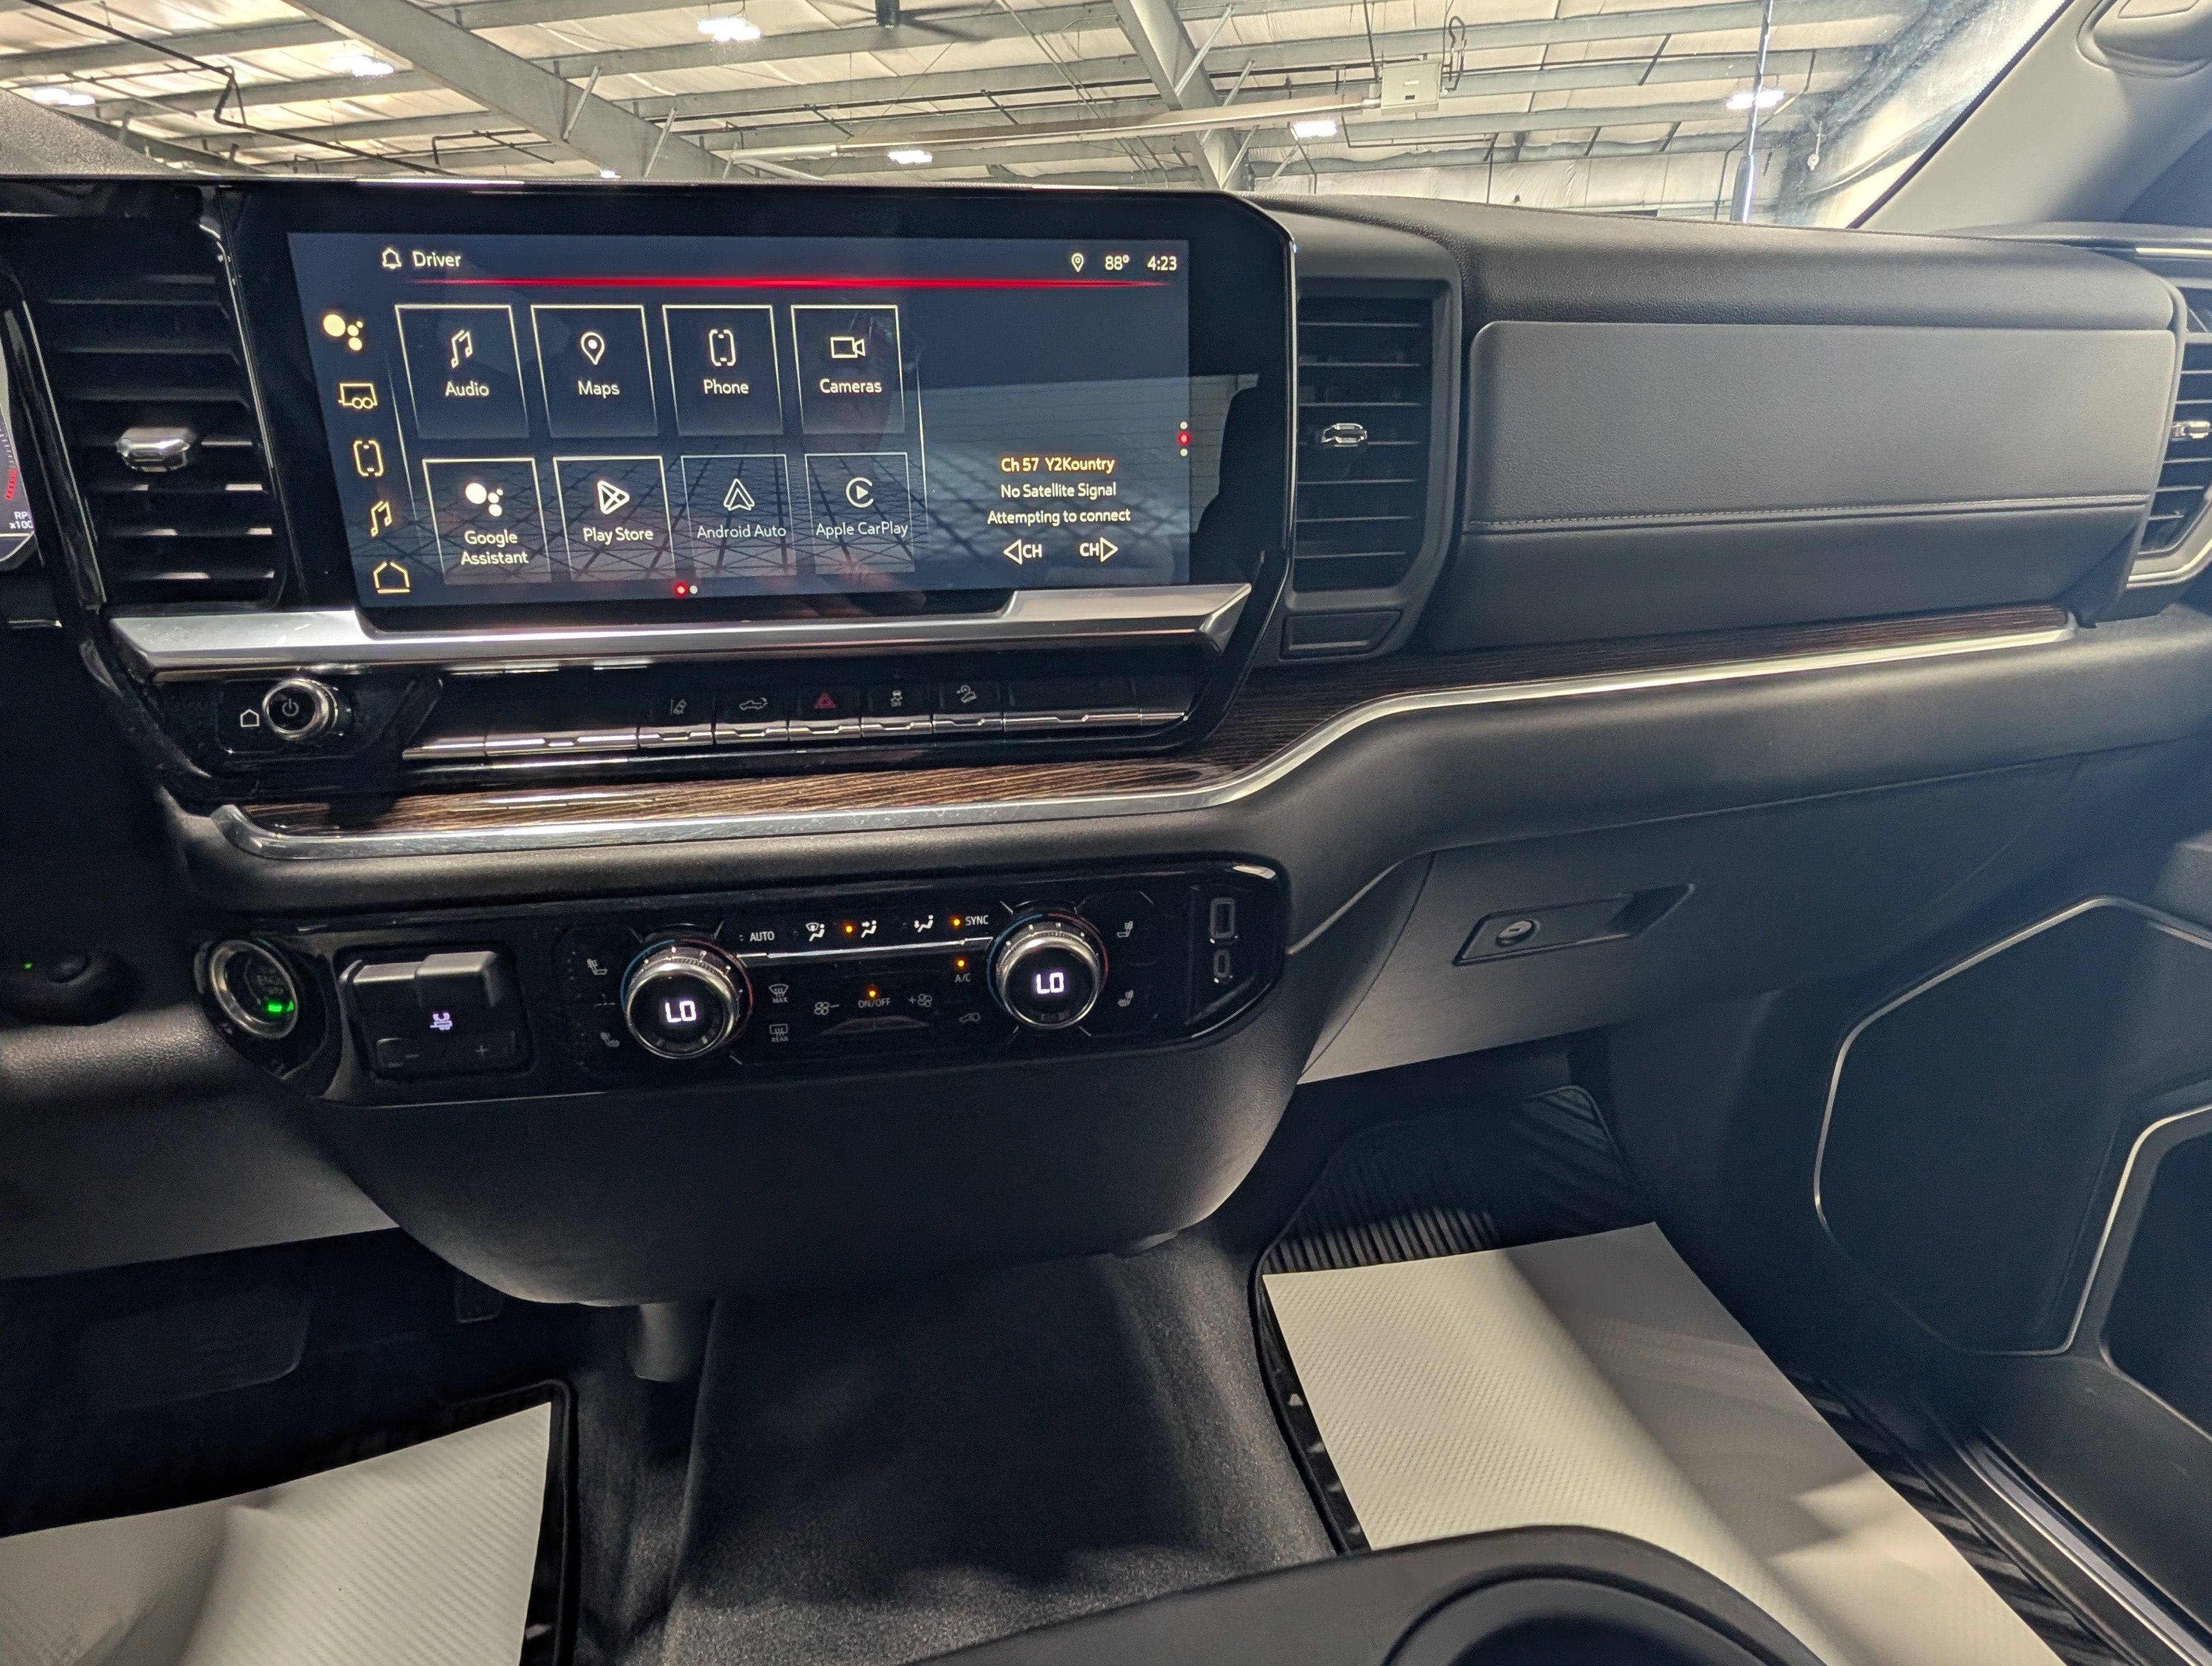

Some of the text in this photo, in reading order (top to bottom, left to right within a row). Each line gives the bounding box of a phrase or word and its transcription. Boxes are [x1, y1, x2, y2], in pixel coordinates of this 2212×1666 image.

[412, 251, 461, 267] Driver
[1147, 255, 1177, 271] 4:23
[445, 380, 490, 396] Audio
[577, 380, 620, 399] Maps
[703, 379, 749, 394] Phone
[819, 378, 882, 393] Cameras
[1001, 457, 1115, 474] Ch 57 Y2Kountry
[1001, 481, 1116, 500] No Satellite Signal
[14, 511, 32, 520] RP
[987, 508, 1131, 527] Attempting to connect
[464, 529, 518, 546] Google
[583, 527, 654, 546] Play Store
[697, 524, 787, 539] Android Auto
[815, 521, 909, 539] Apple CarPlay
[1022, 543, 1043, 559] CH
[1079, 542, 1099, 557] CH
[461, 550, 529, 566] Assistant
[965, 915, 988, 926] SYNC
[750, 931, 775, 942] AUTO
[954, 973, 971, 983] A/C
[858, 997, 890, 1008] ON/OFF
